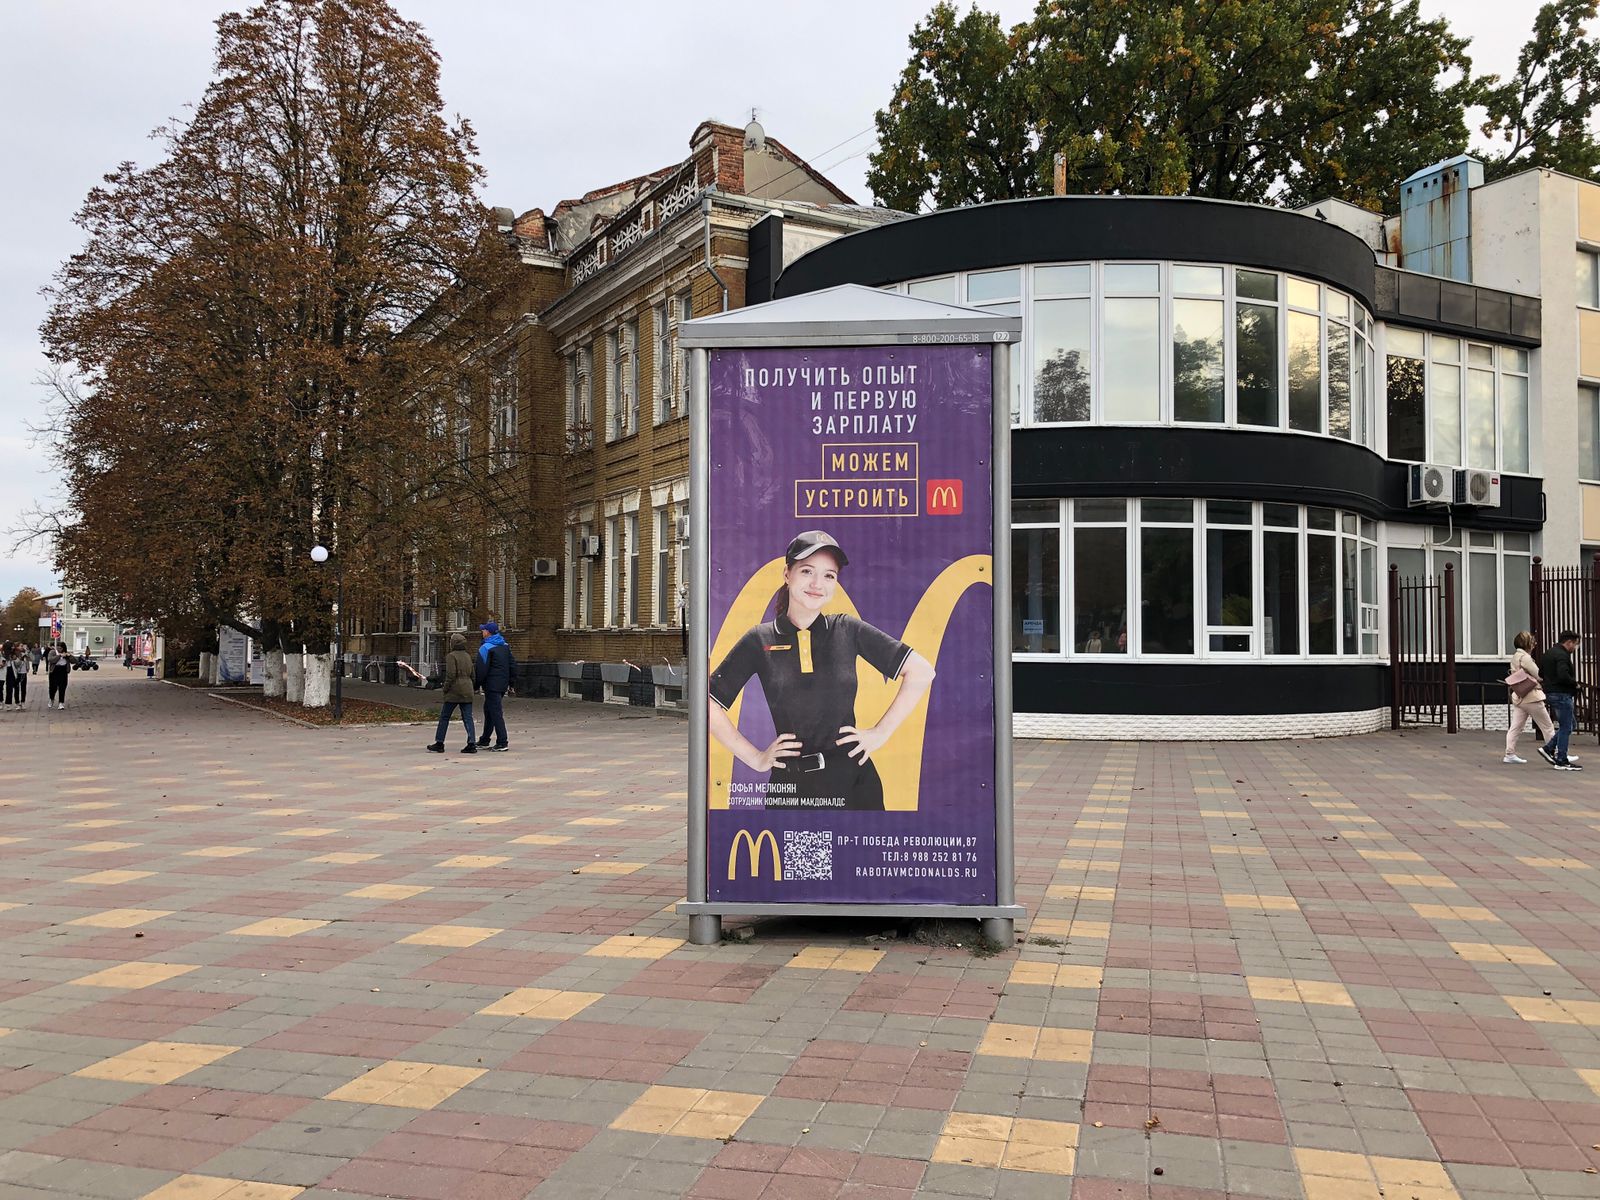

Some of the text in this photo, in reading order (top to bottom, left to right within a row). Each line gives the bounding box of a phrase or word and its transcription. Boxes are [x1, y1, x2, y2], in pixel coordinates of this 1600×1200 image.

[912, 333, 979, 343] 8-800-200-65-18
[745, 365, 918, 388] ПОЛУЧИТЬ ОПЫТ
[811, 390, 917, 410] И ПЕРВУЮ
[812, 414, 918, 435] ЗАРПЛАТУ
[831, 453, 909, 472] МОЖЕМ
[805, 487, 909, 508] УСТРОИТЬ
[727, 782, 797, 794] СОФЬЯ МЕЛКОНЯН
[727, 796, 846, 807] СОТРУДНИК КОМПАНИИ МАКДОНАЛДС
[837, 835, 977, 848] ПР-Т ПОБЕДА РЕВОЛЮЦИИ,87
[882, 852, 978, 862] ТЕЛ:8 988 252 81 76
[855, 866, 978, 878] RABOTAVMCDONALDS.RU
